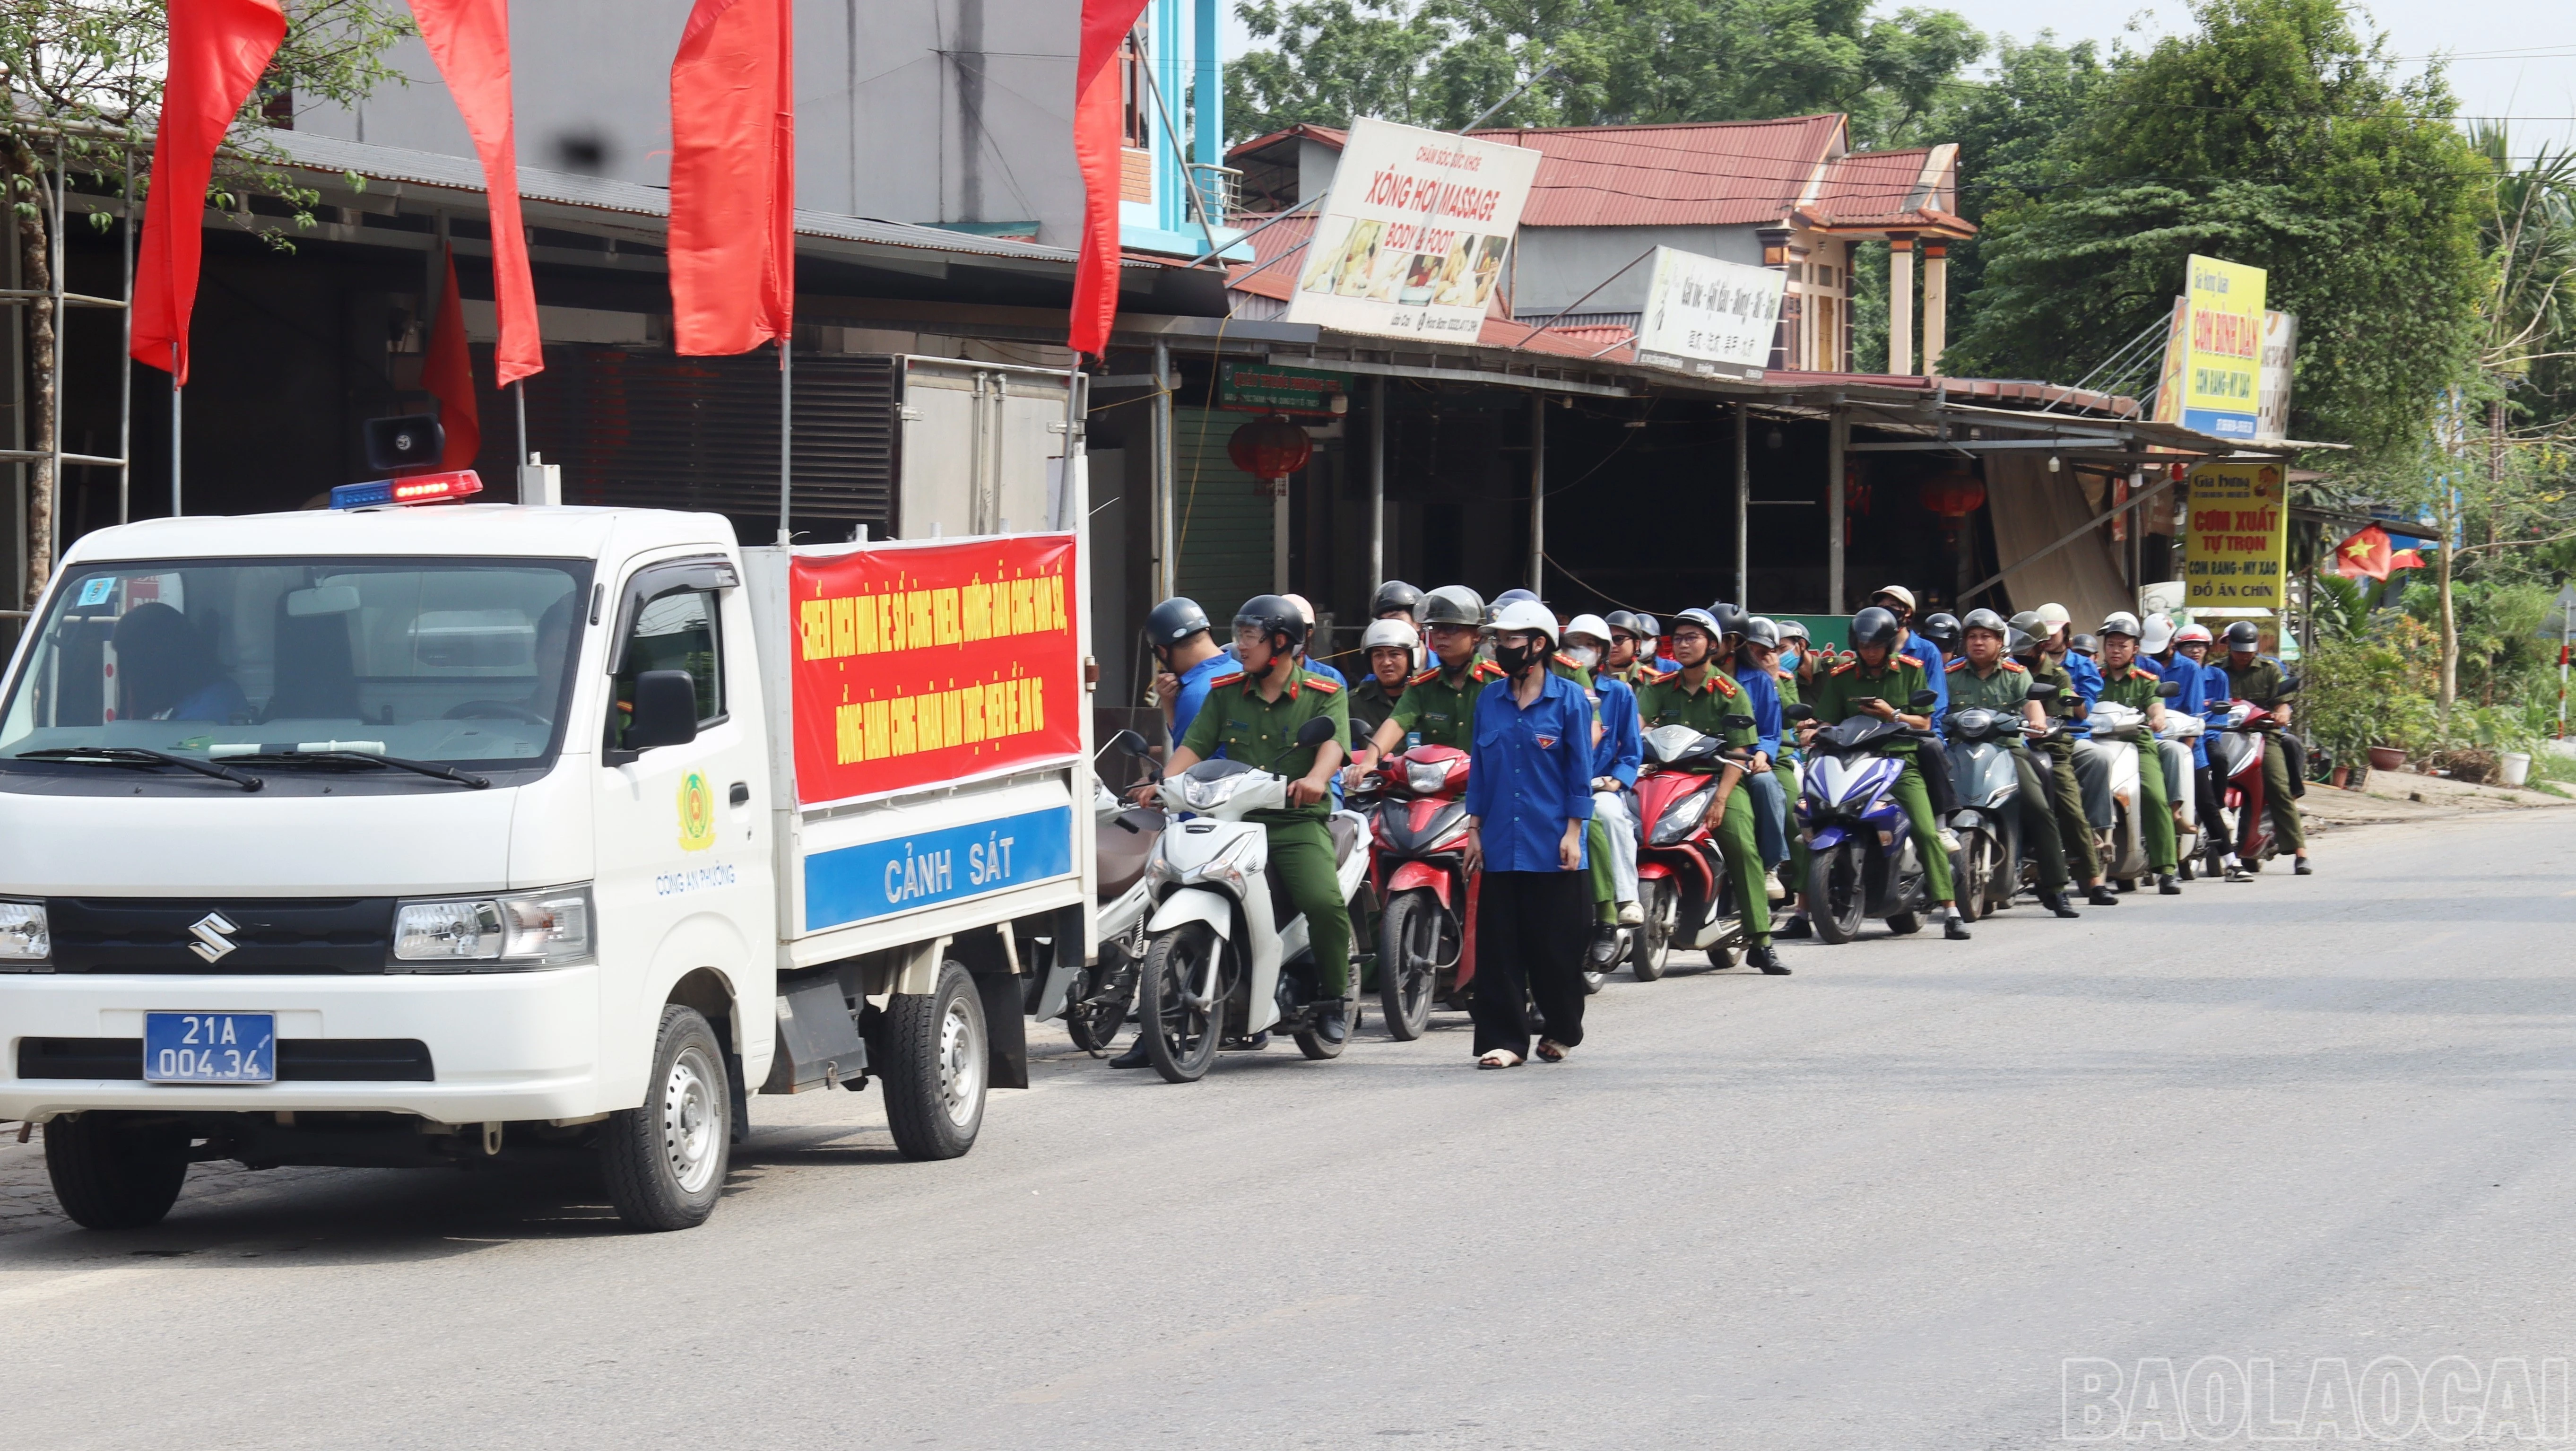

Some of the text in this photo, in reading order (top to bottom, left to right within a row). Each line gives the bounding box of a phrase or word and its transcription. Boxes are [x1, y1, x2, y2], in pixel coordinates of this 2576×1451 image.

[1363, 163, 1501, 222] XÔNG HƠI MASSAGE
[1384, 222, 1456, 255] BODY & FOOT
[2194, 474, 2214, 488] Gia
[2194, 504, 2278, 532] CƠM XUẤT
[2202, 534, 2267, 555] TỰ TRỌN
[2217, 582, 2237, 597] ĂN
[2241, 582, 2273, 597] CHÍN
[878, 581, 893, 653] HÈ
[893, 571, 906, 652] SỐ
[992, 559, 1011, 638] DẪN
[1011, 567, 1034, 634] CÔNG
[1034, 565, 1052, 632] DÂN
[890, 685, 916, 757] CÙNG
[916, 681, 943, 752] NHÂN
[942, 678, 962, 747] DÂN
[1006, 660, 1019, 736] ĐỀ
[1019, 666, 1033, 733] ÁN
[884, 830, 1015, 904] CẢNH SÁT
[656, 870, 684, 896] CÔNG
[685, 869, 700, 890] AN
[182, 1016, 237, 1045] 21A
[159, 1048, 260, 1078] 004.34
